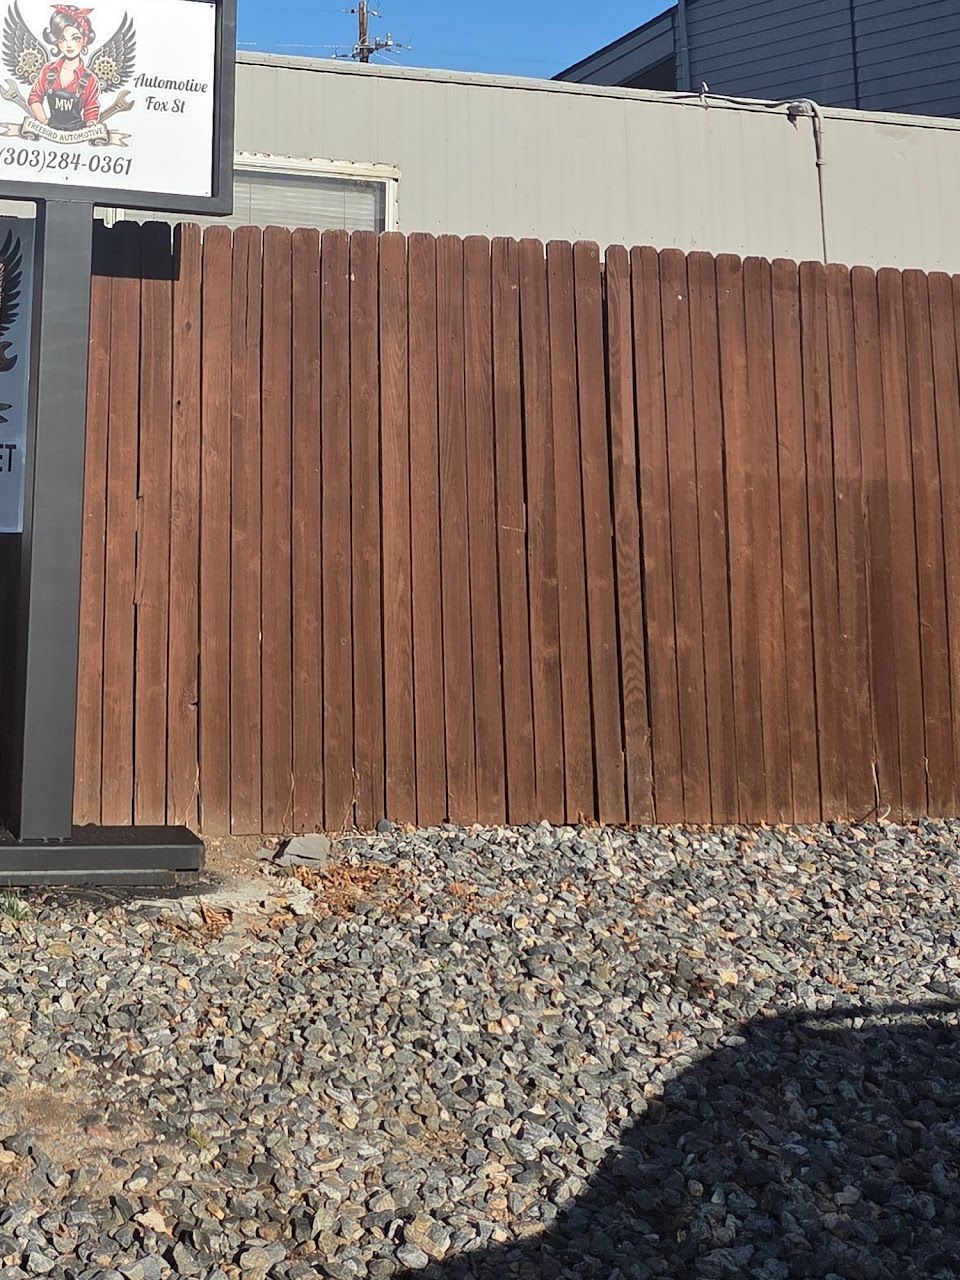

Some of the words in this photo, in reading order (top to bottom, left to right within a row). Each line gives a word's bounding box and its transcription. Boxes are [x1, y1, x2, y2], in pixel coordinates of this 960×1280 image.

[133, 73, 208, 93] Automotive
[55, 98, 74, 111] MW
[145, 96, 169, 113] Fox
[171, 98, 186, 113] St
[27, 120, 58, 140] FREEBIRD
[59, 127, 104, 141] AUTOMOTIVE
